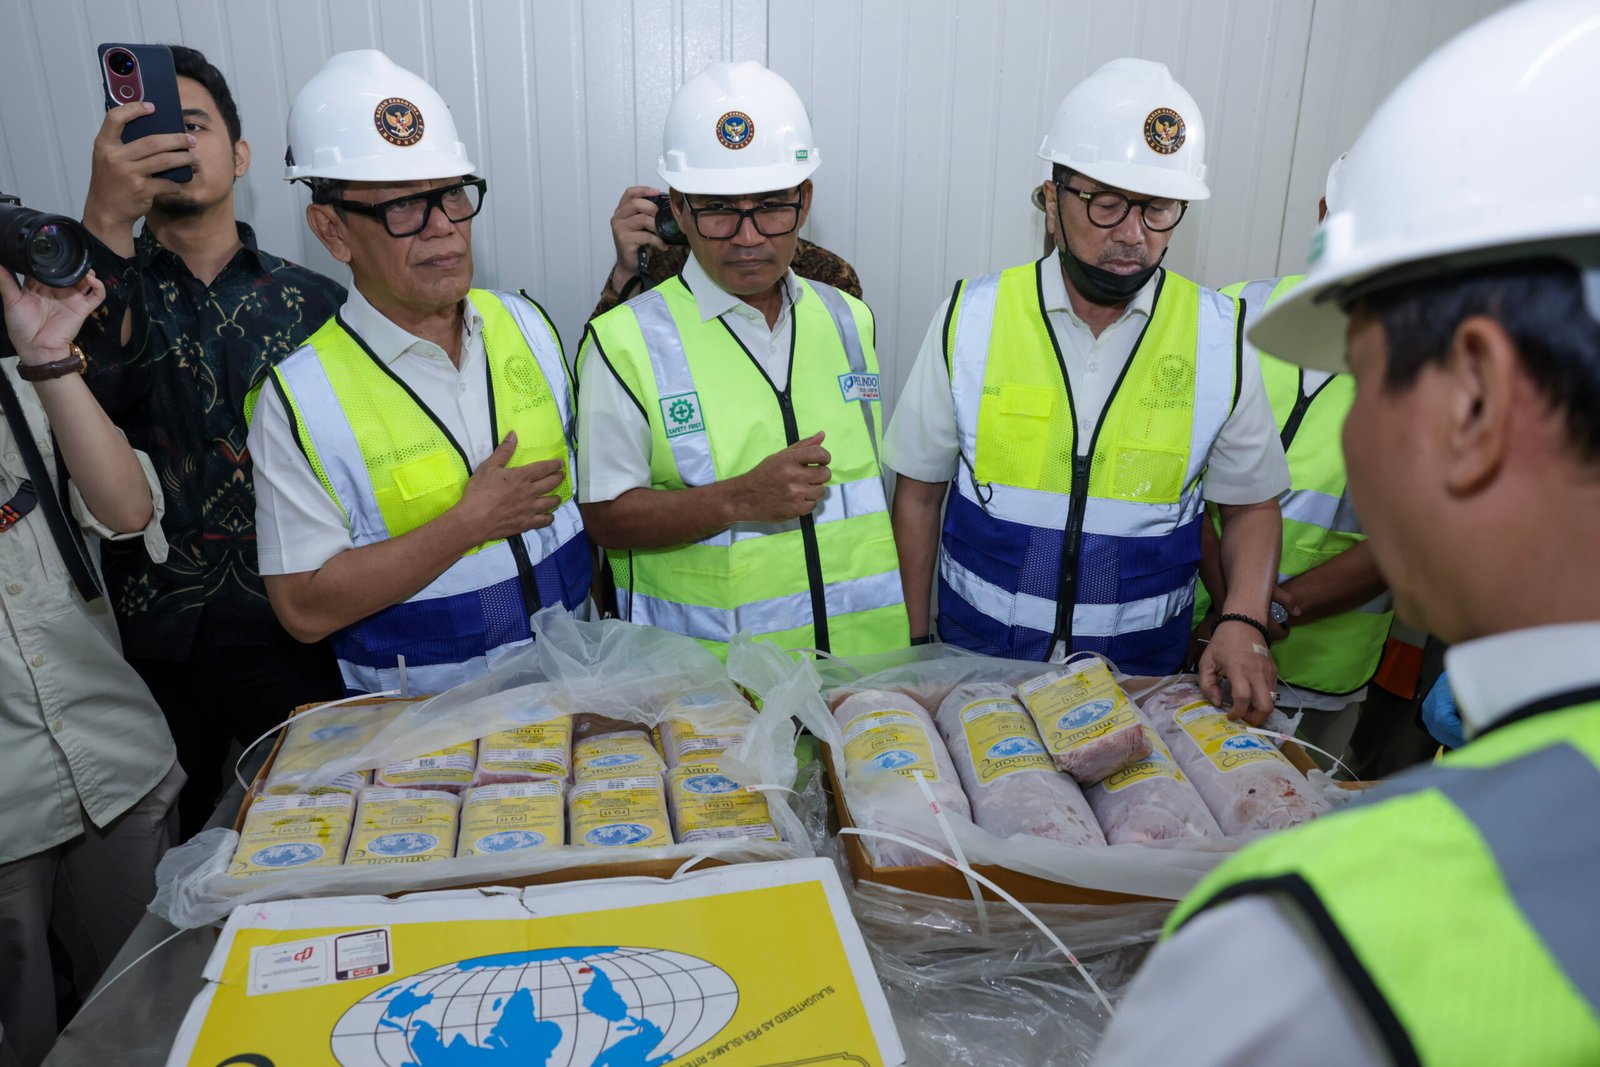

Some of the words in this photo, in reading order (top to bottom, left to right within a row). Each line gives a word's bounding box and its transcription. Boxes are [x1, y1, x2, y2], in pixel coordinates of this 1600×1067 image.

[853, 376, 877, 387] PELINDO
[668, 425, 687, 434] SAFETY
[1068, 715, 1119, 742] Amroon
[682, 766, 720, 774] Amro
[366, 855, 432, 865] Amroon
[775, 985, 836, 1024] SLAUGHTERED
[762, 1020, 775, 1032] AS
[743, 1028, 762, 1041] PER
[707, 1036, 745, 1059] ISLAMIC
